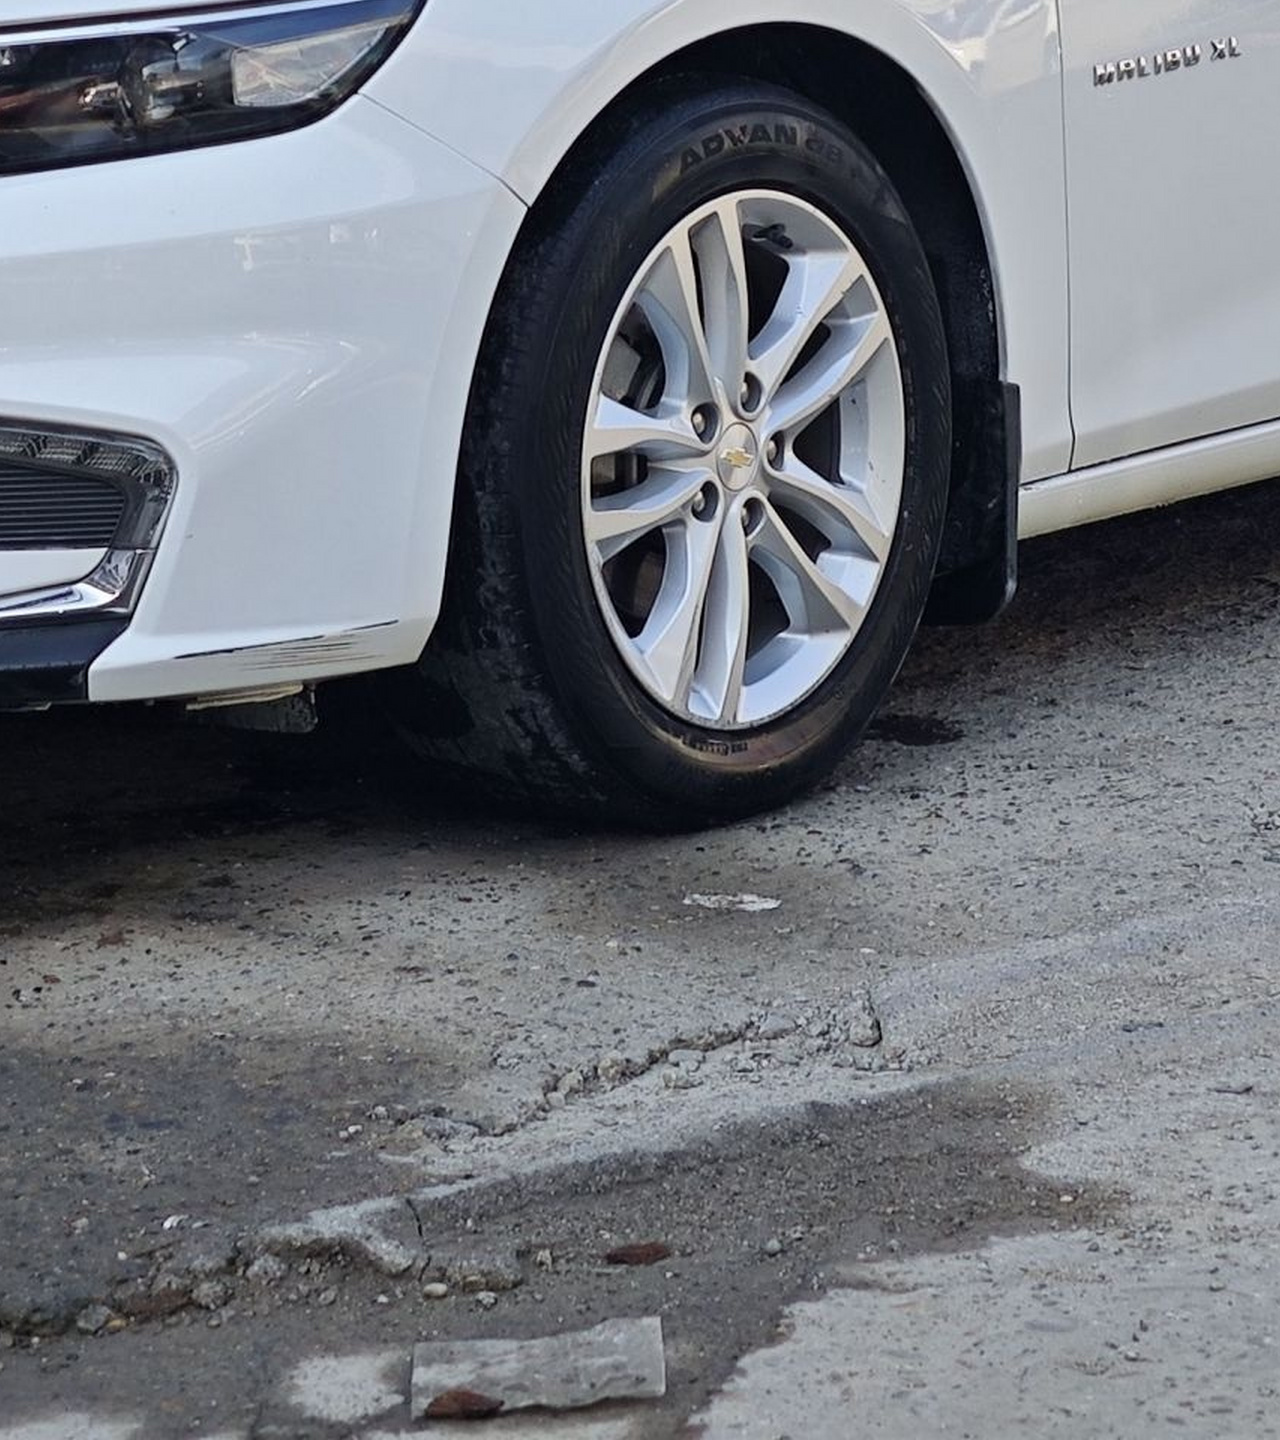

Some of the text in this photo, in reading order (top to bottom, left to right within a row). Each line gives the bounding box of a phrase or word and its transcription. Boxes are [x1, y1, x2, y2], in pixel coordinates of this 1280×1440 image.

[1093, 35, 1242, 87] MALIBU XL
[677, 123, 798, 175] ADVAN
